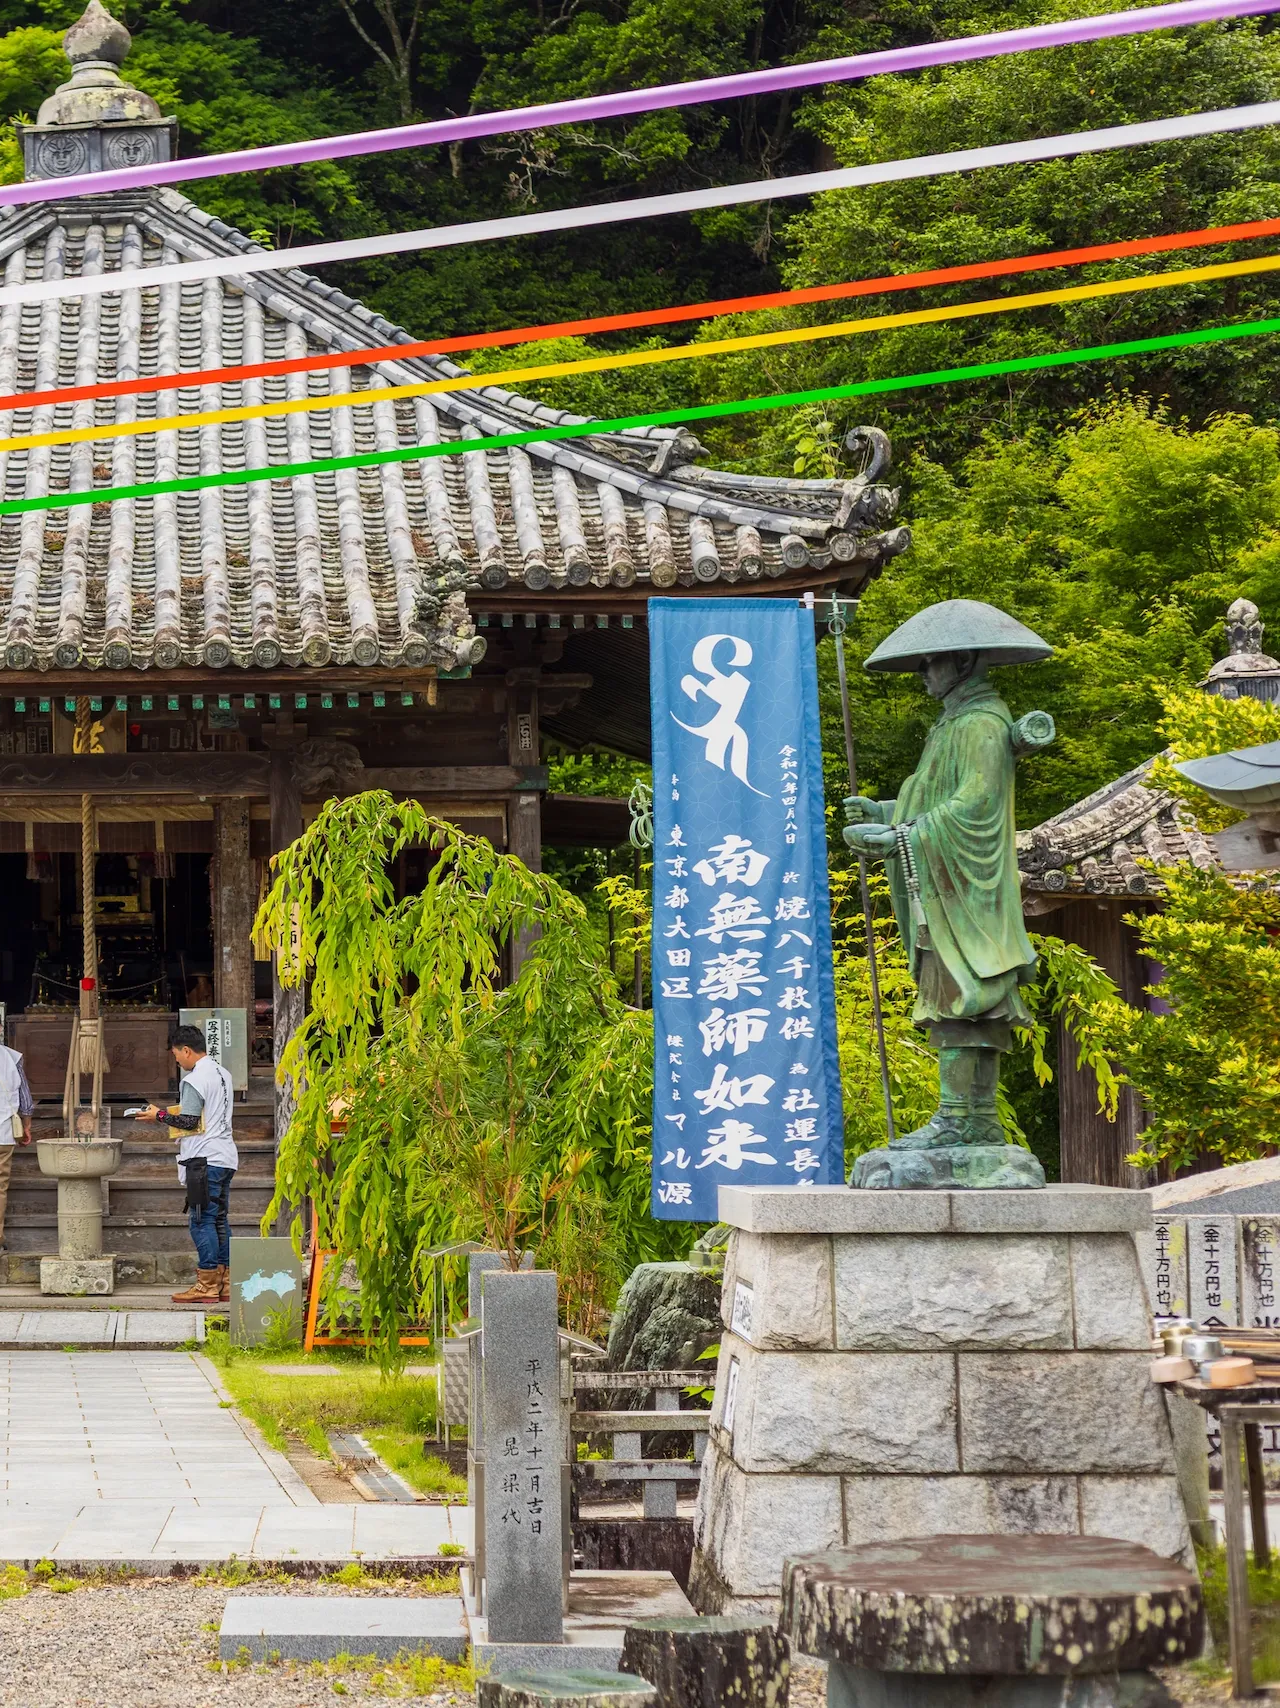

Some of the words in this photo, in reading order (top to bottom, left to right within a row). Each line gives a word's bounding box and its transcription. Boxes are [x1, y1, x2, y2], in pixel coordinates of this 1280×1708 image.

[661, 824, 694, 998] 東京都大田区
[207, 1021, 220, 1064] 写経奉
[525, 1359, 544, 1535] 平成二年十一月吉日
